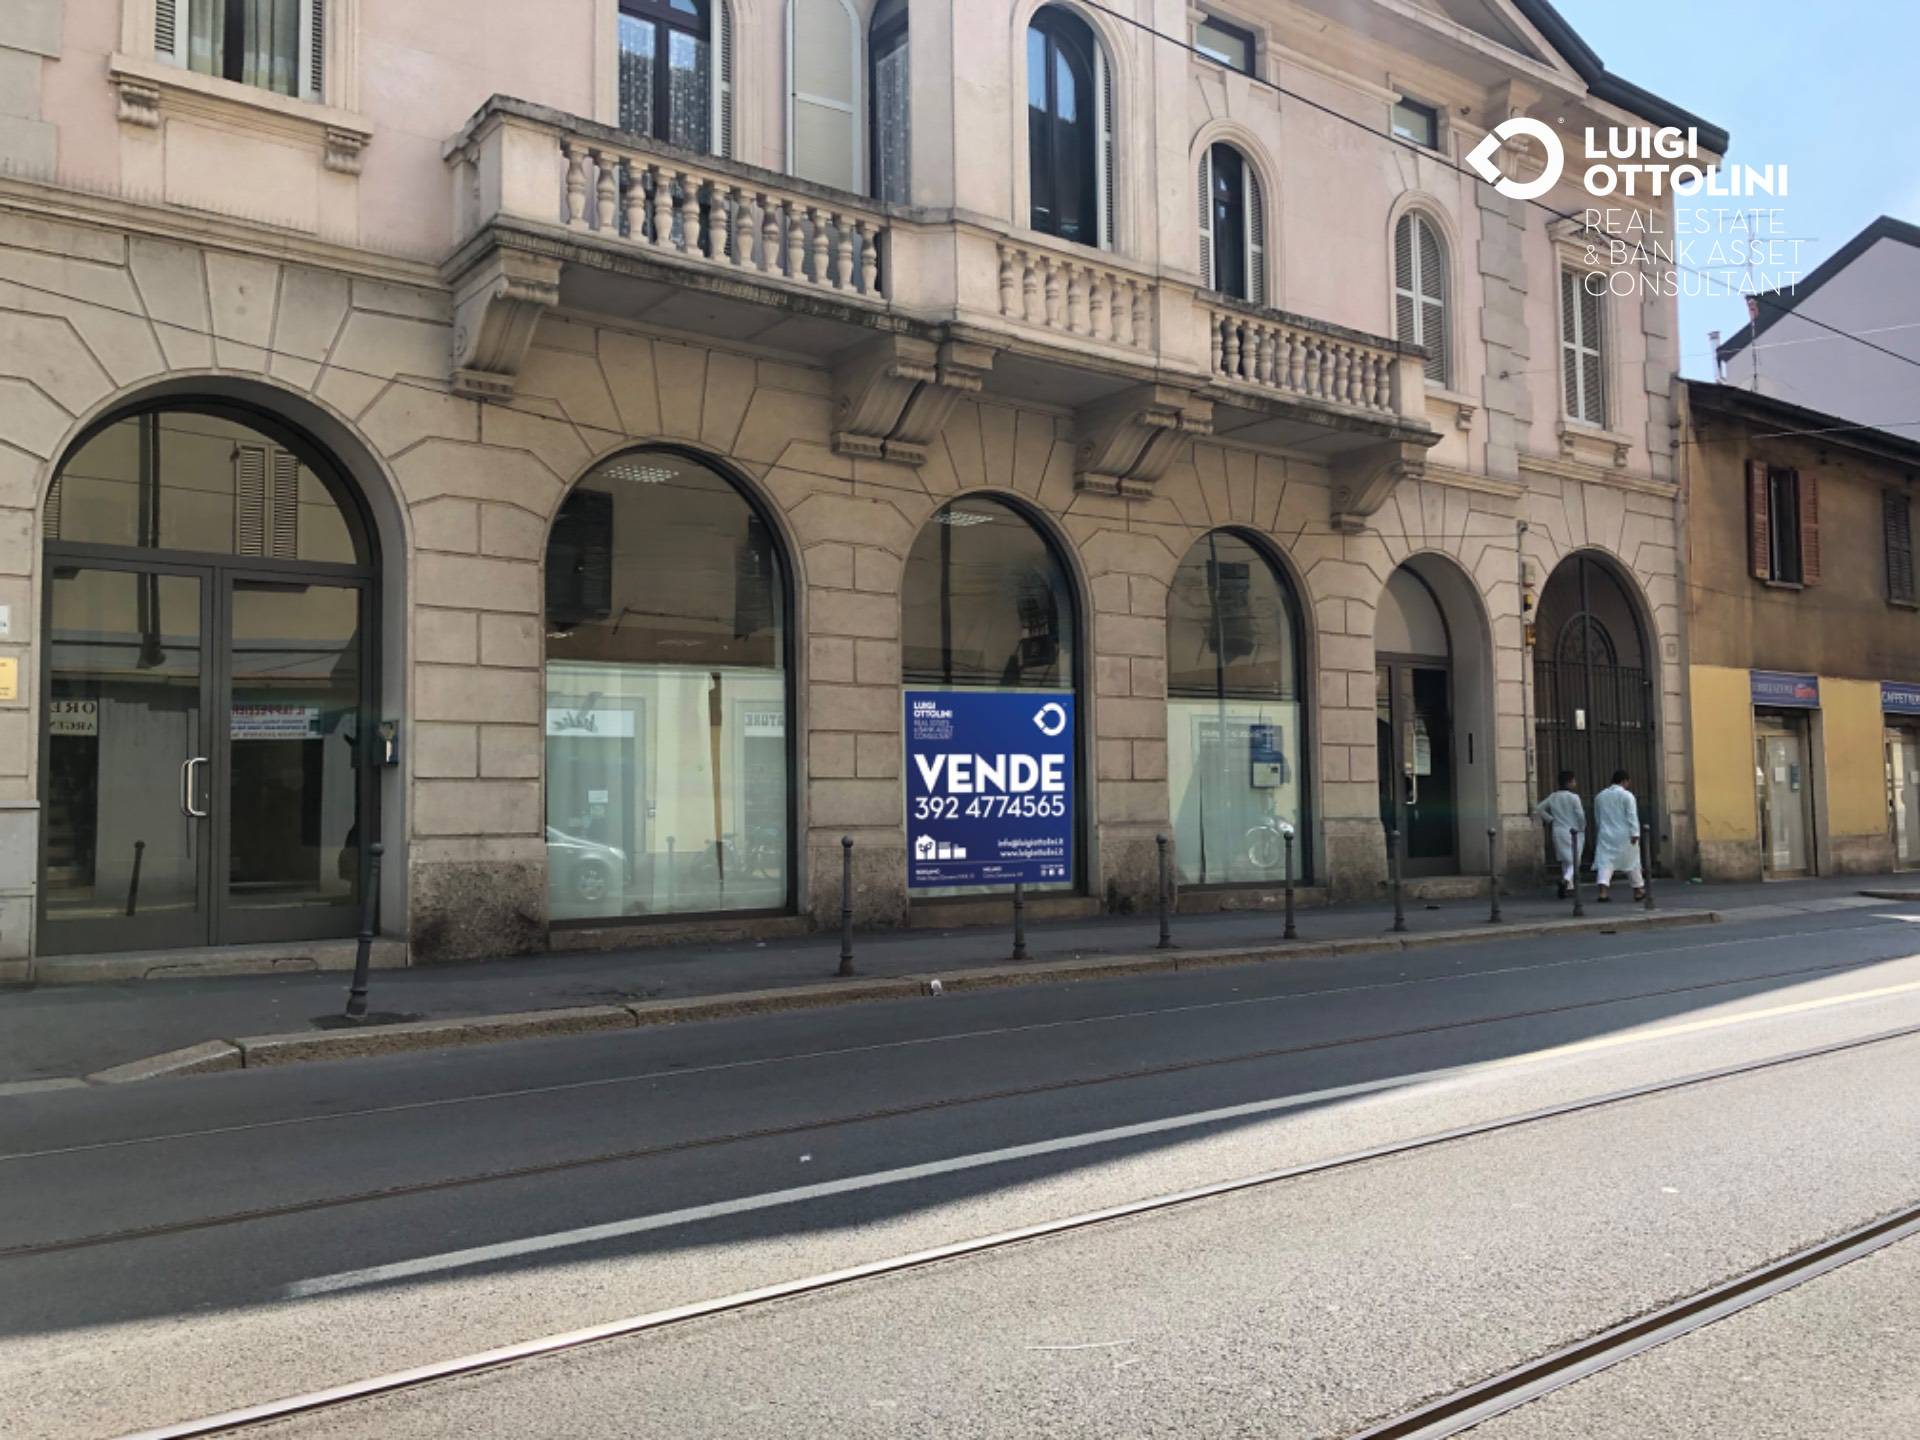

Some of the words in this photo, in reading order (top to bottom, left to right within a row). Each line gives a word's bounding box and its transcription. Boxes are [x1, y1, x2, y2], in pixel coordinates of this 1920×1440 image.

[913, 710, 953, 718] OTTOLINI
[914, 754, 1065, 793] VENDE
[915, 797, 959, 819] 392
[965, 796, 1065, 818] 4774565
